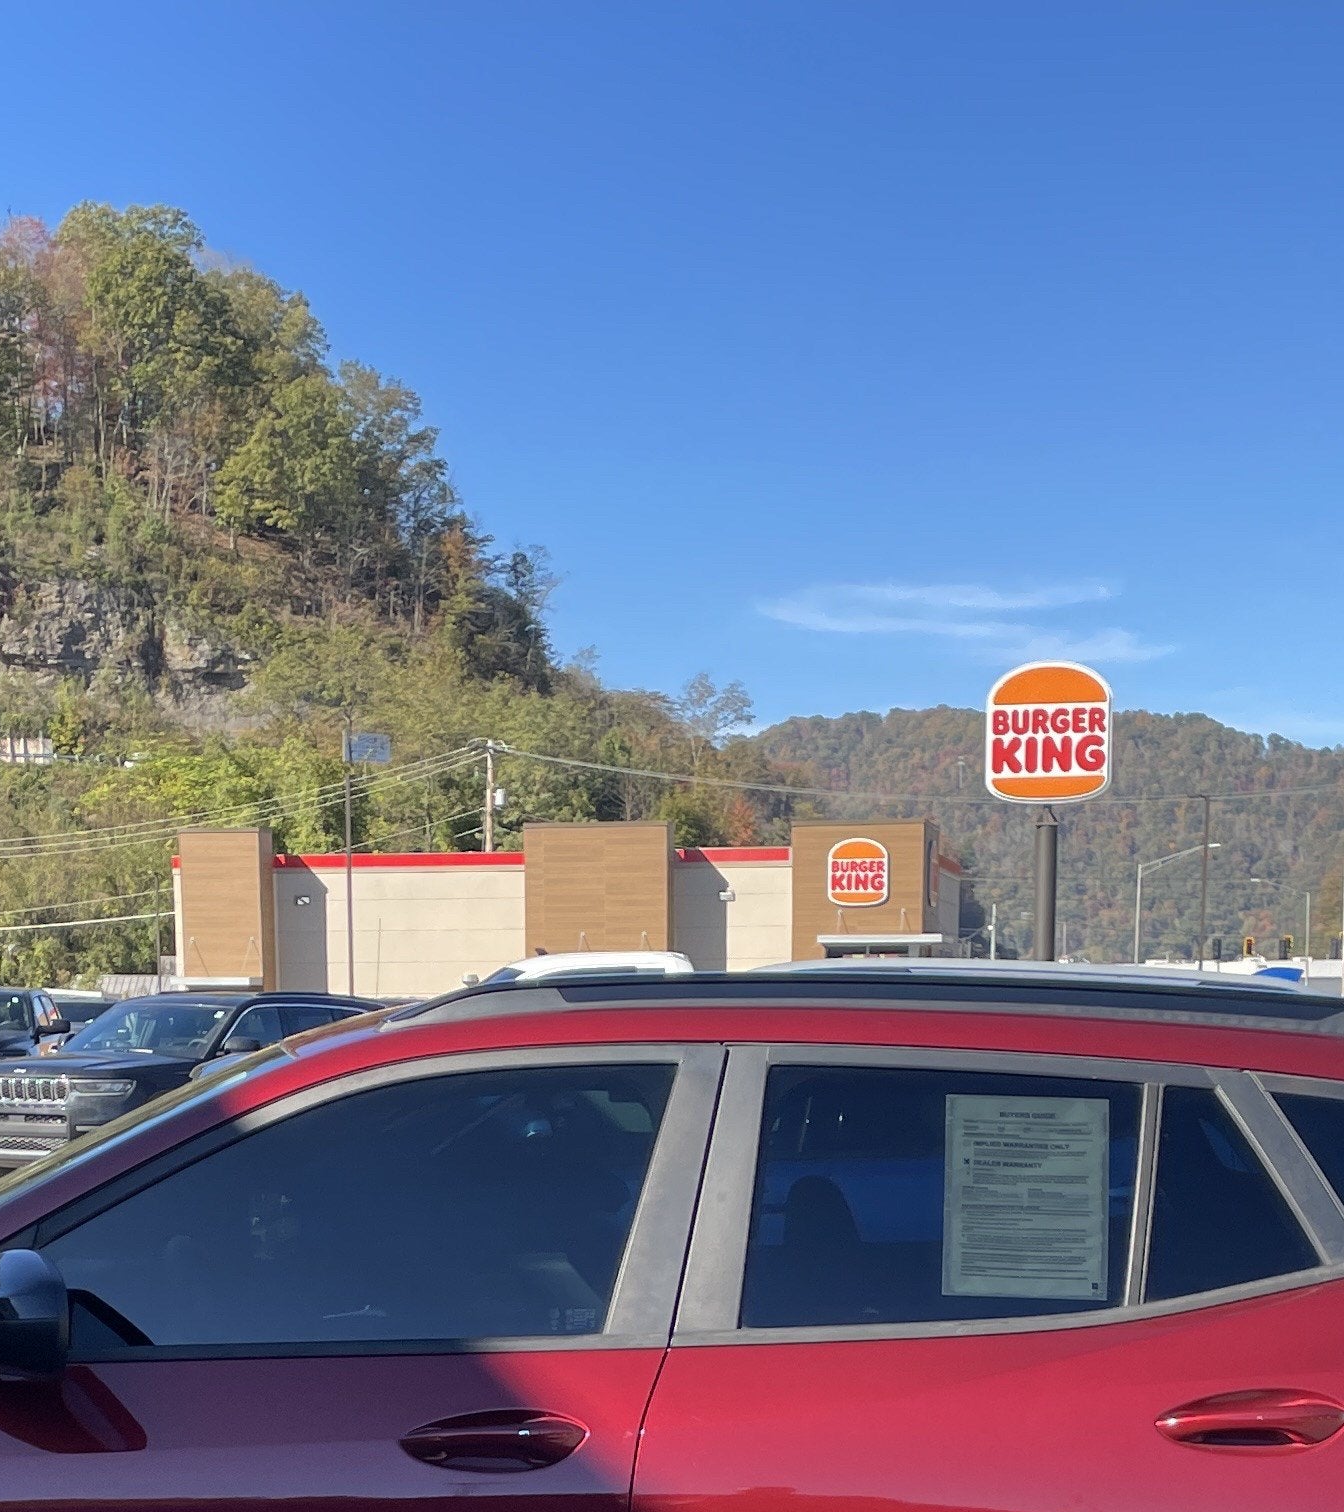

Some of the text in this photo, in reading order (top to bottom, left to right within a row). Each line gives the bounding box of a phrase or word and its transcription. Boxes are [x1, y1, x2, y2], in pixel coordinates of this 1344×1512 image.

[991, 706, 1107, 736] BURGER
[991, 735, 1106, 774] KING
[830, 859, 886, 874] BURGER
[830, 872, 886, 892] KING
